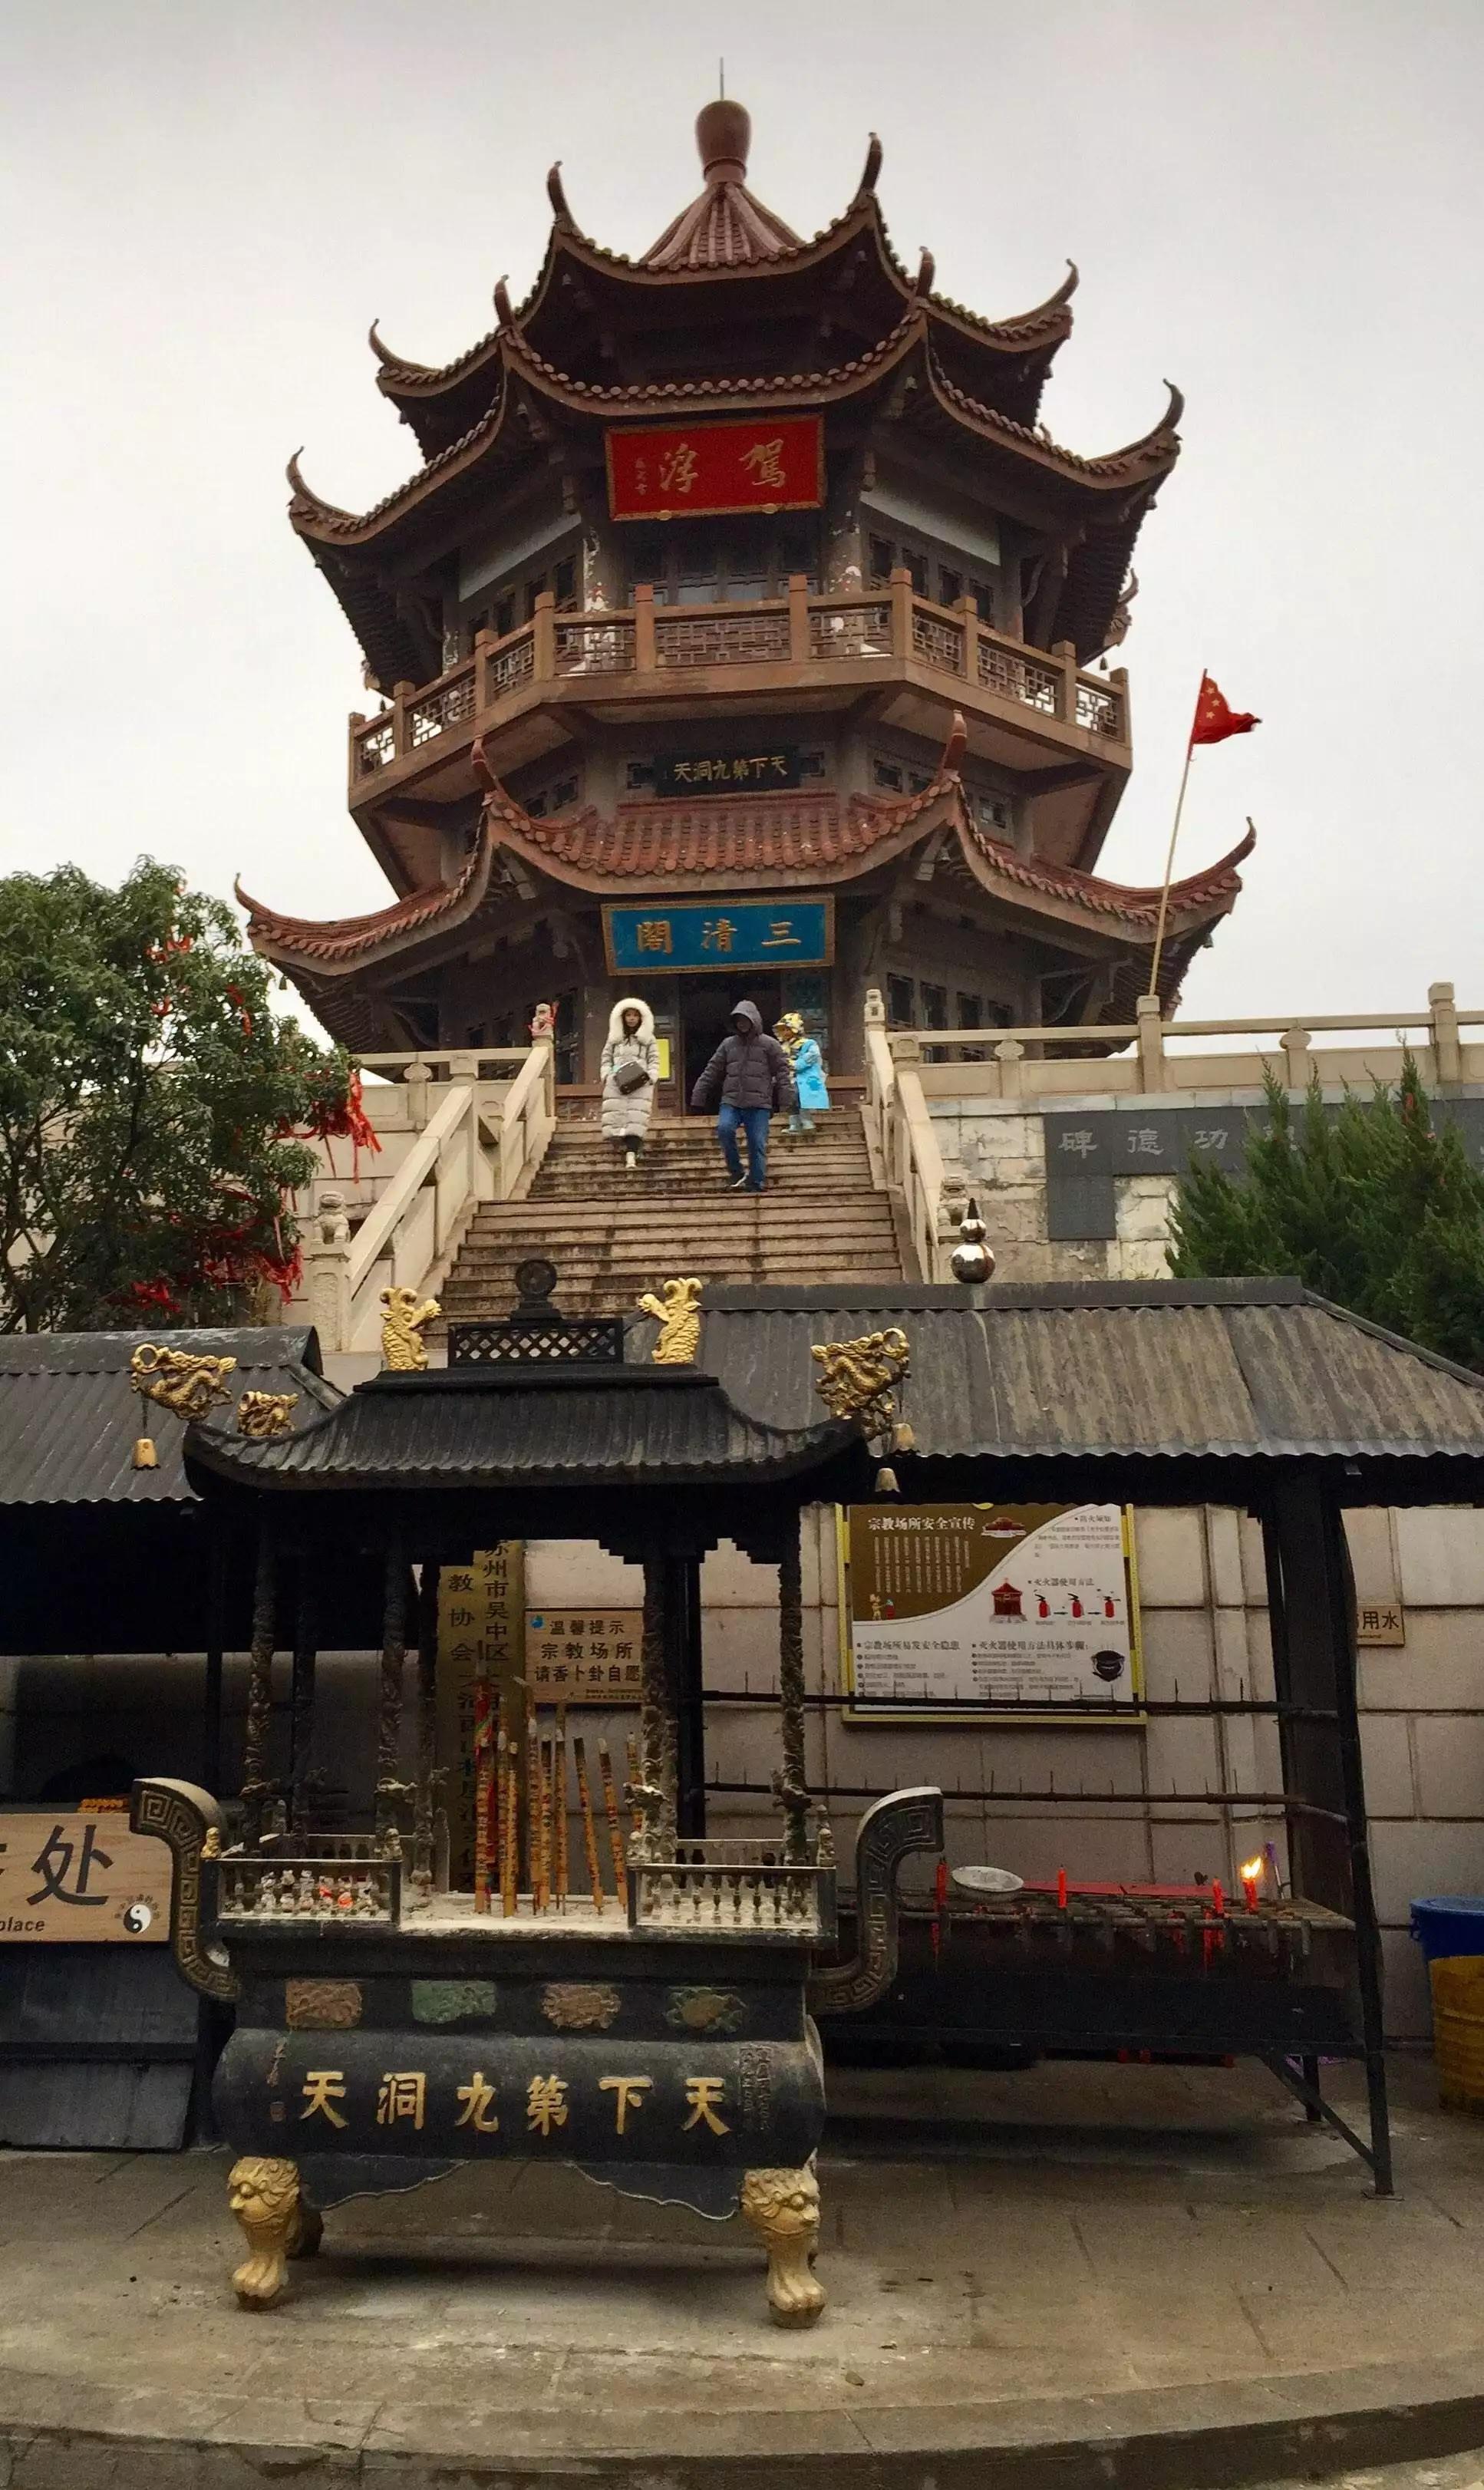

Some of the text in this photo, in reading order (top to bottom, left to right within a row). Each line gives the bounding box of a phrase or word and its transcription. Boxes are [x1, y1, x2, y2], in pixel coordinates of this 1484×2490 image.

[868, 1515, 975, 1532] 宗教场所安全宣传
[549, 1620, 625, 1635] 温馨提示
[1357, 1611, 1400, 1629] 用水
[541, 1642, 633, 1660] 宗教场所
[0, 1824, 114, 1905] 处
